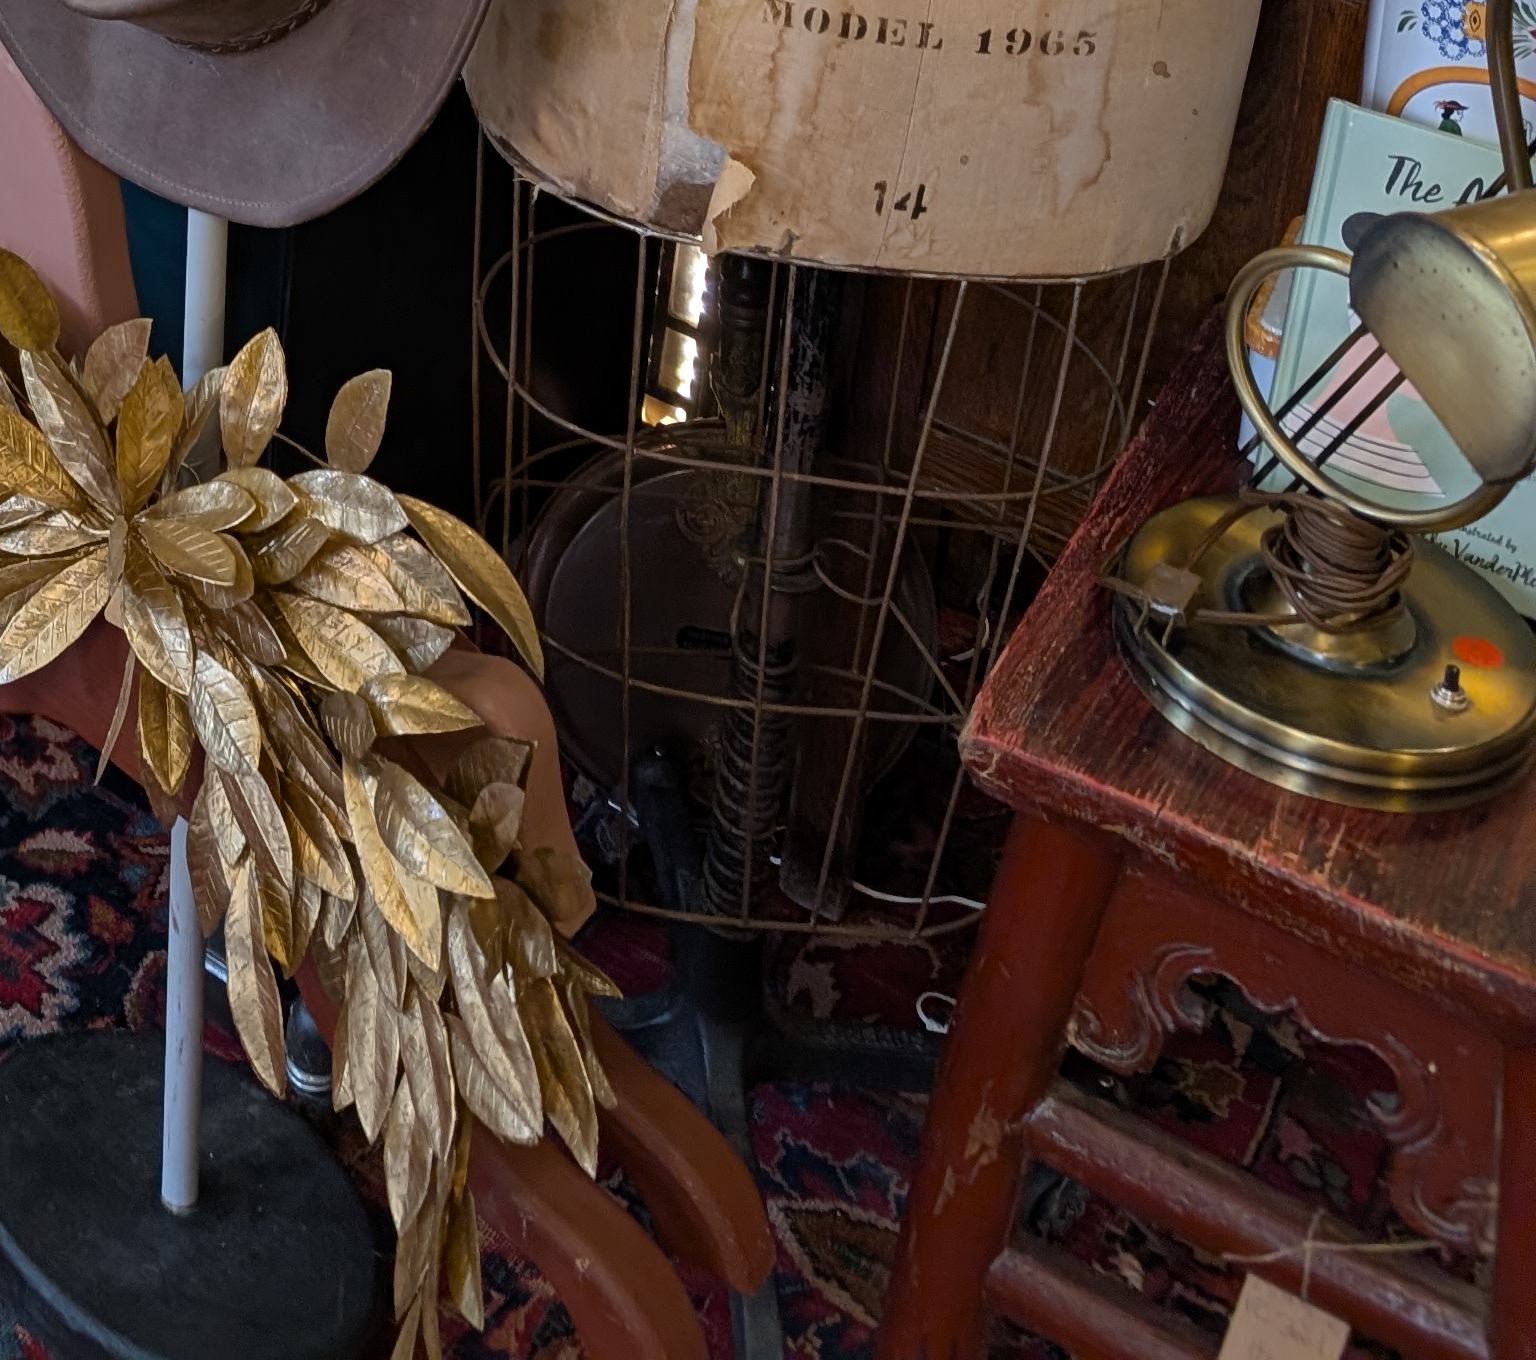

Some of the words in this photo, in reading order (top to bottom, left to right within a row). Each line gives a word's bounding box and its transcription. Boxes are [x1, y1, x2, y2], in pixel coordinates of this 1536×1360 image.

[762, 0, 944, 51] MODEL
[975, 28, 1098, 58] 1965
[874, 181, 928, 220] 14
[1385, 154, 1444, 203] The
